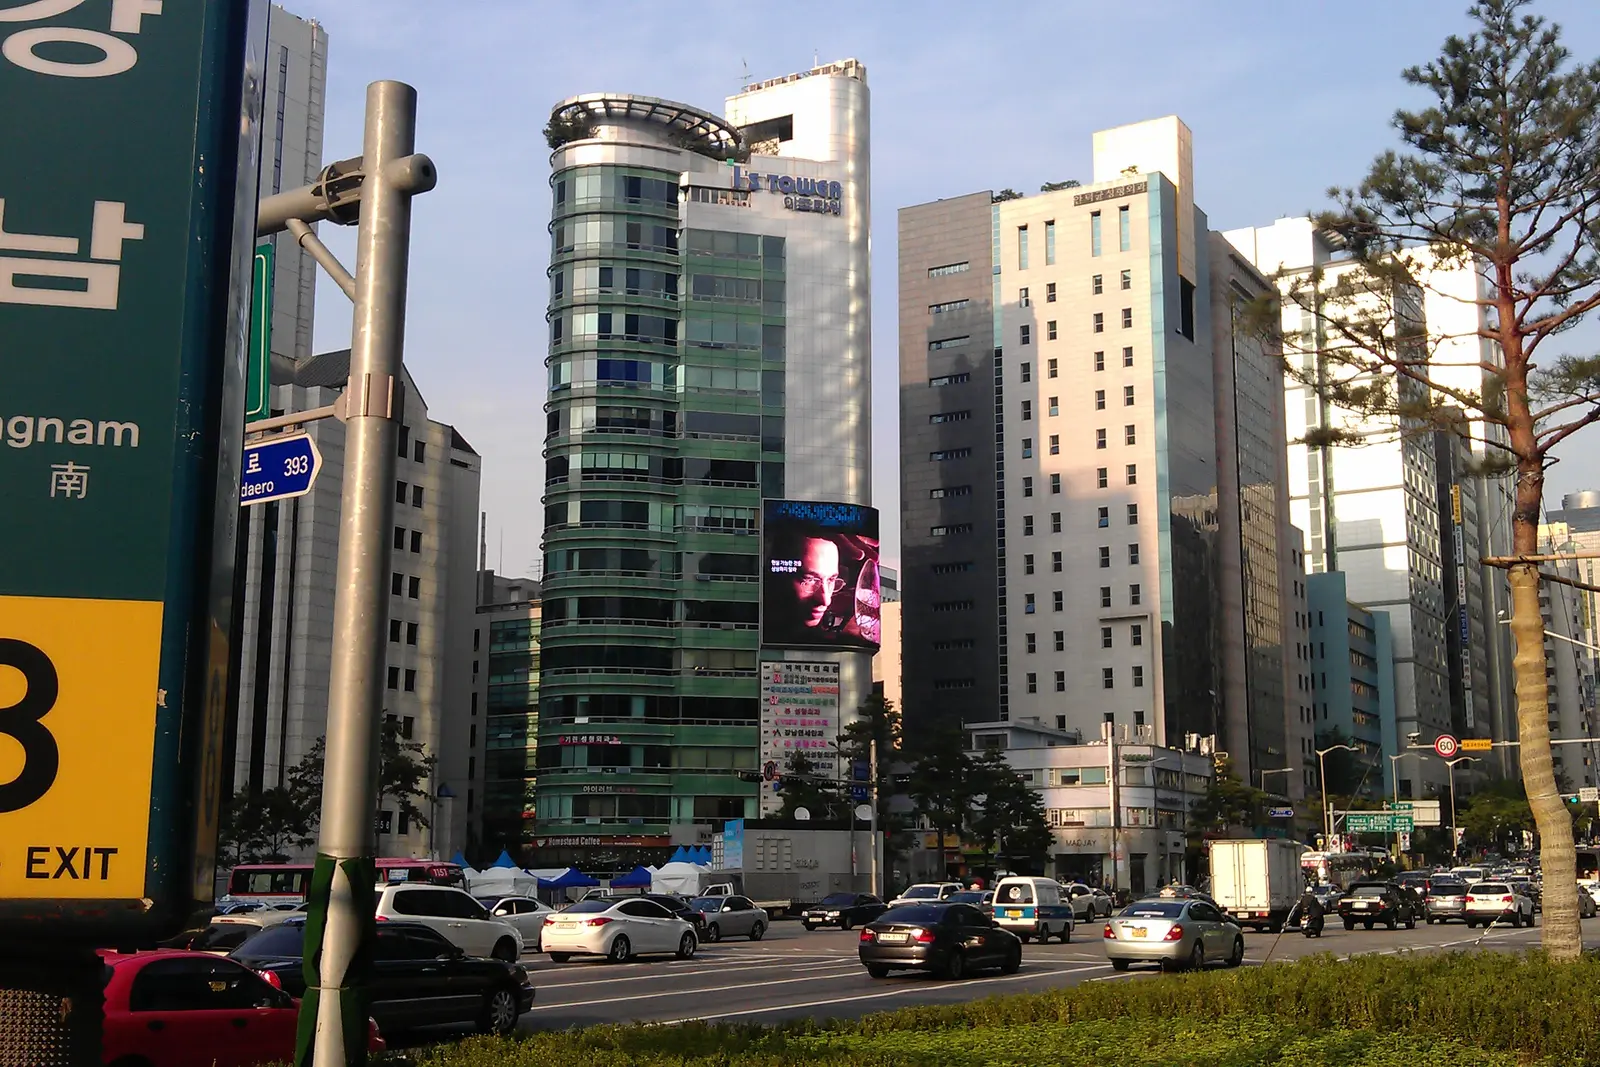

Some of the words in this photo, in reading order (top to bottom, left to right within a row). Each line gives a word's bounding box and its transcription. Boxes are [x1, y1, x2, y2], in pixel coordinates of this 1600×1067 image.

[766, 174, 842, 199] TOWER
[0, 414, 140, 449] gnam
[283, 455, 309, 477] 393
[50, 460, 91, 500] 南
[1440, 741, 1453, 751] 60
[580, 836, 600, 846] Coffee
[25, 845, 119, 880] EXIT
